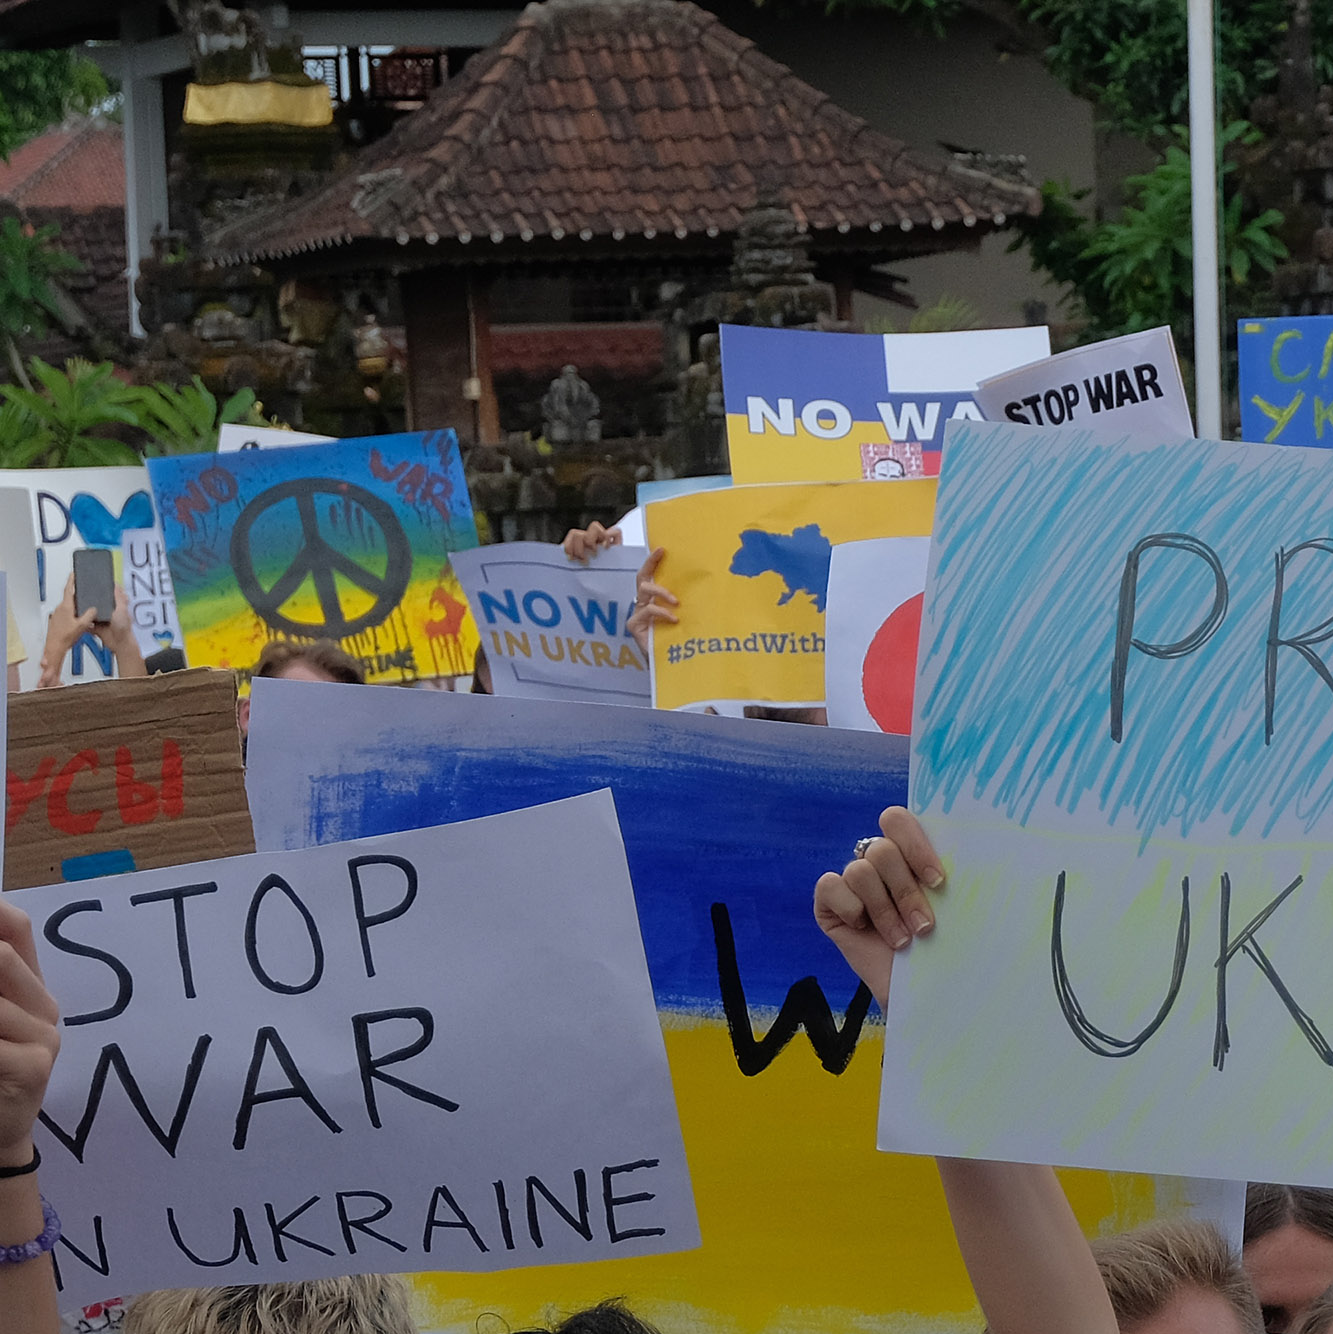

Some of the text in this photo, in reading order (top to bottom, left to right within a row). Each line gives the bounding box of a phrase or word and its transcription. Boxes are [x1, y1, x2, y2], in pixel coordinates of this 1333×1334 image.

[746, 396, 853, 440] NO
[1005, 363, 1163, 427] STOP WAR
[477, 588, 562, 629] NO
[490, 630, 532, 659] IN
[667, 632, 825, 665] #StandWith
[43, 854, 418, 1027] STOP
[37, 1006, 459, 1163] WAR
[167, 1159, 666, 1267] UKRAINE
